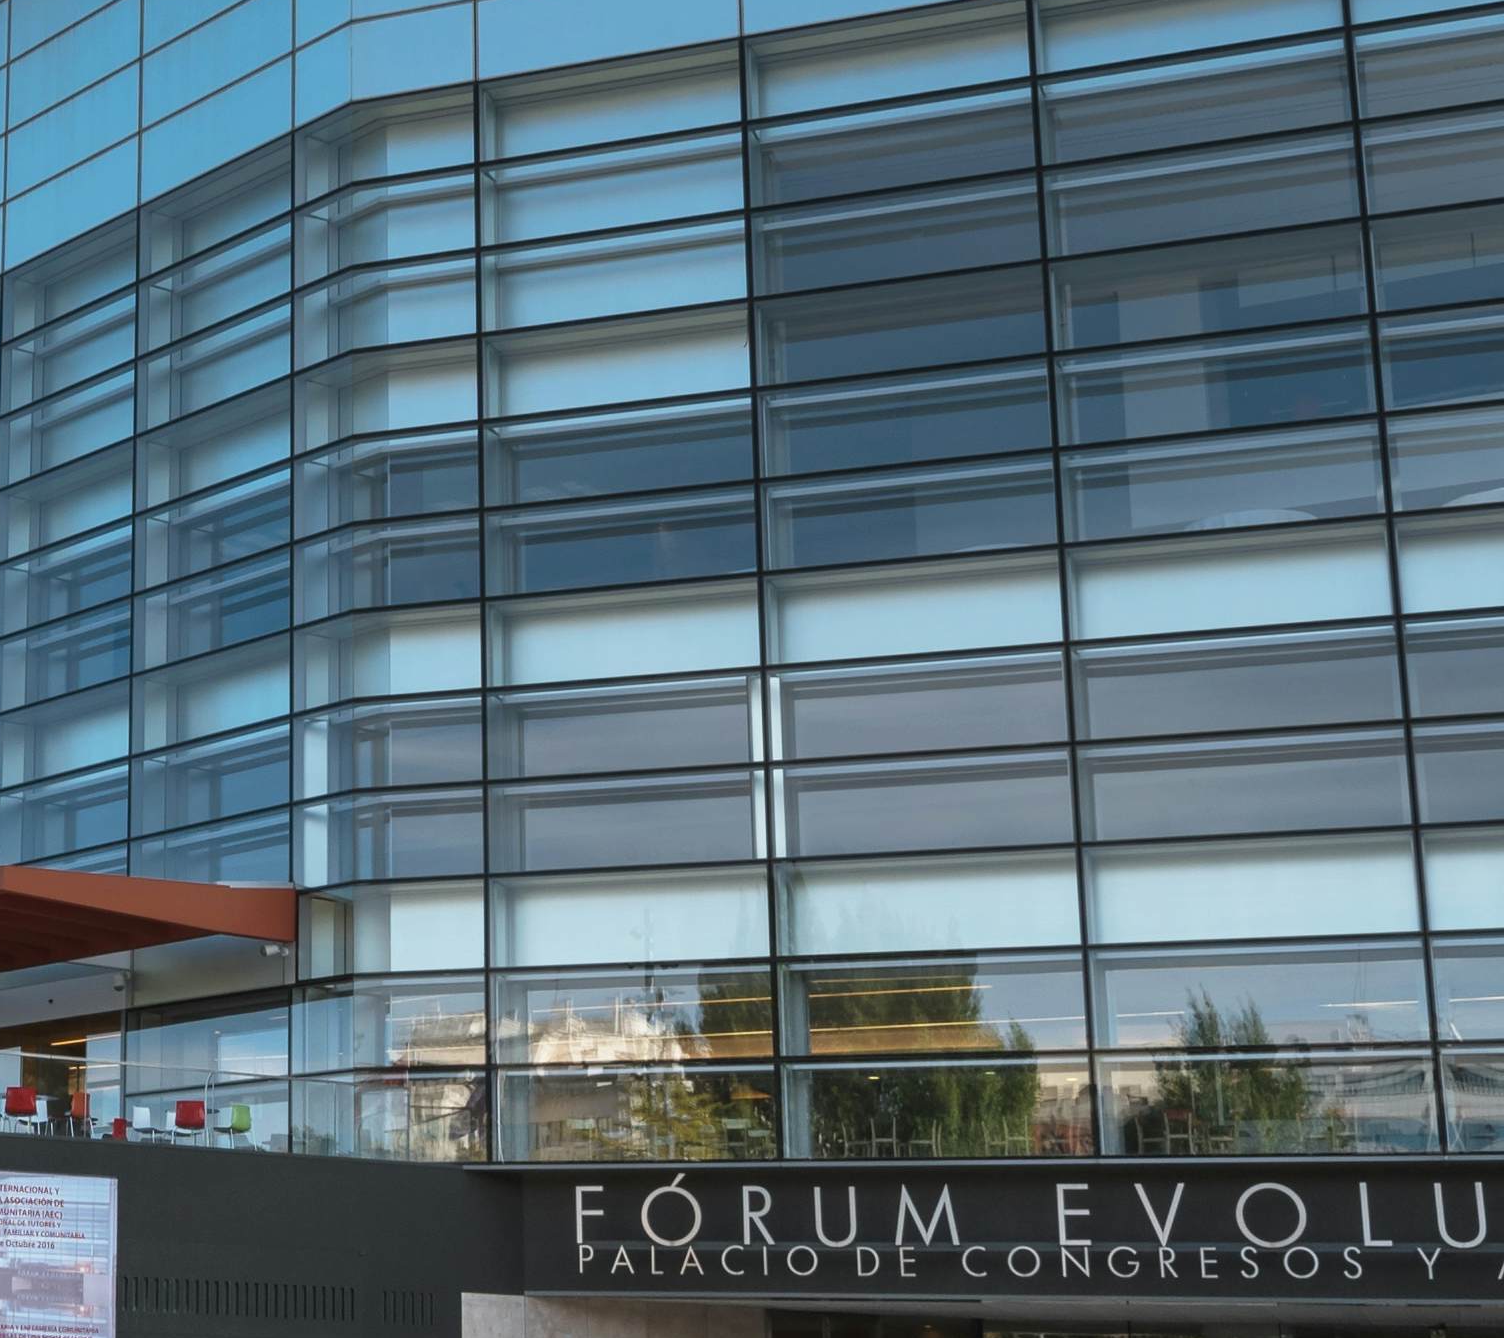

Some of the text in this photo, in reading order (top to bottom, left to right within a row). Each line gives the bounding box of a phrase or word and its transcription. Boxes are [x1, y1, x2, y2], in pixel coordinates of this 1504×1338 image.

[54, 1186, 60, 1195] Y
[3, 1196, 52, 1207] ASOCIACIÓN
[53, 1199, 65, 1208] DE
[575, 1173, 960, 1247] FÓRUM
[5, 1239, 35, 1249] Octubre
[579, 1245, 818, 1276] PALACIO
[858, 1246, 917, 1277] DE
[962, 1246, 1363, 1279] CONGRESOS
[1418, 1247, 1441, 1280] Y
